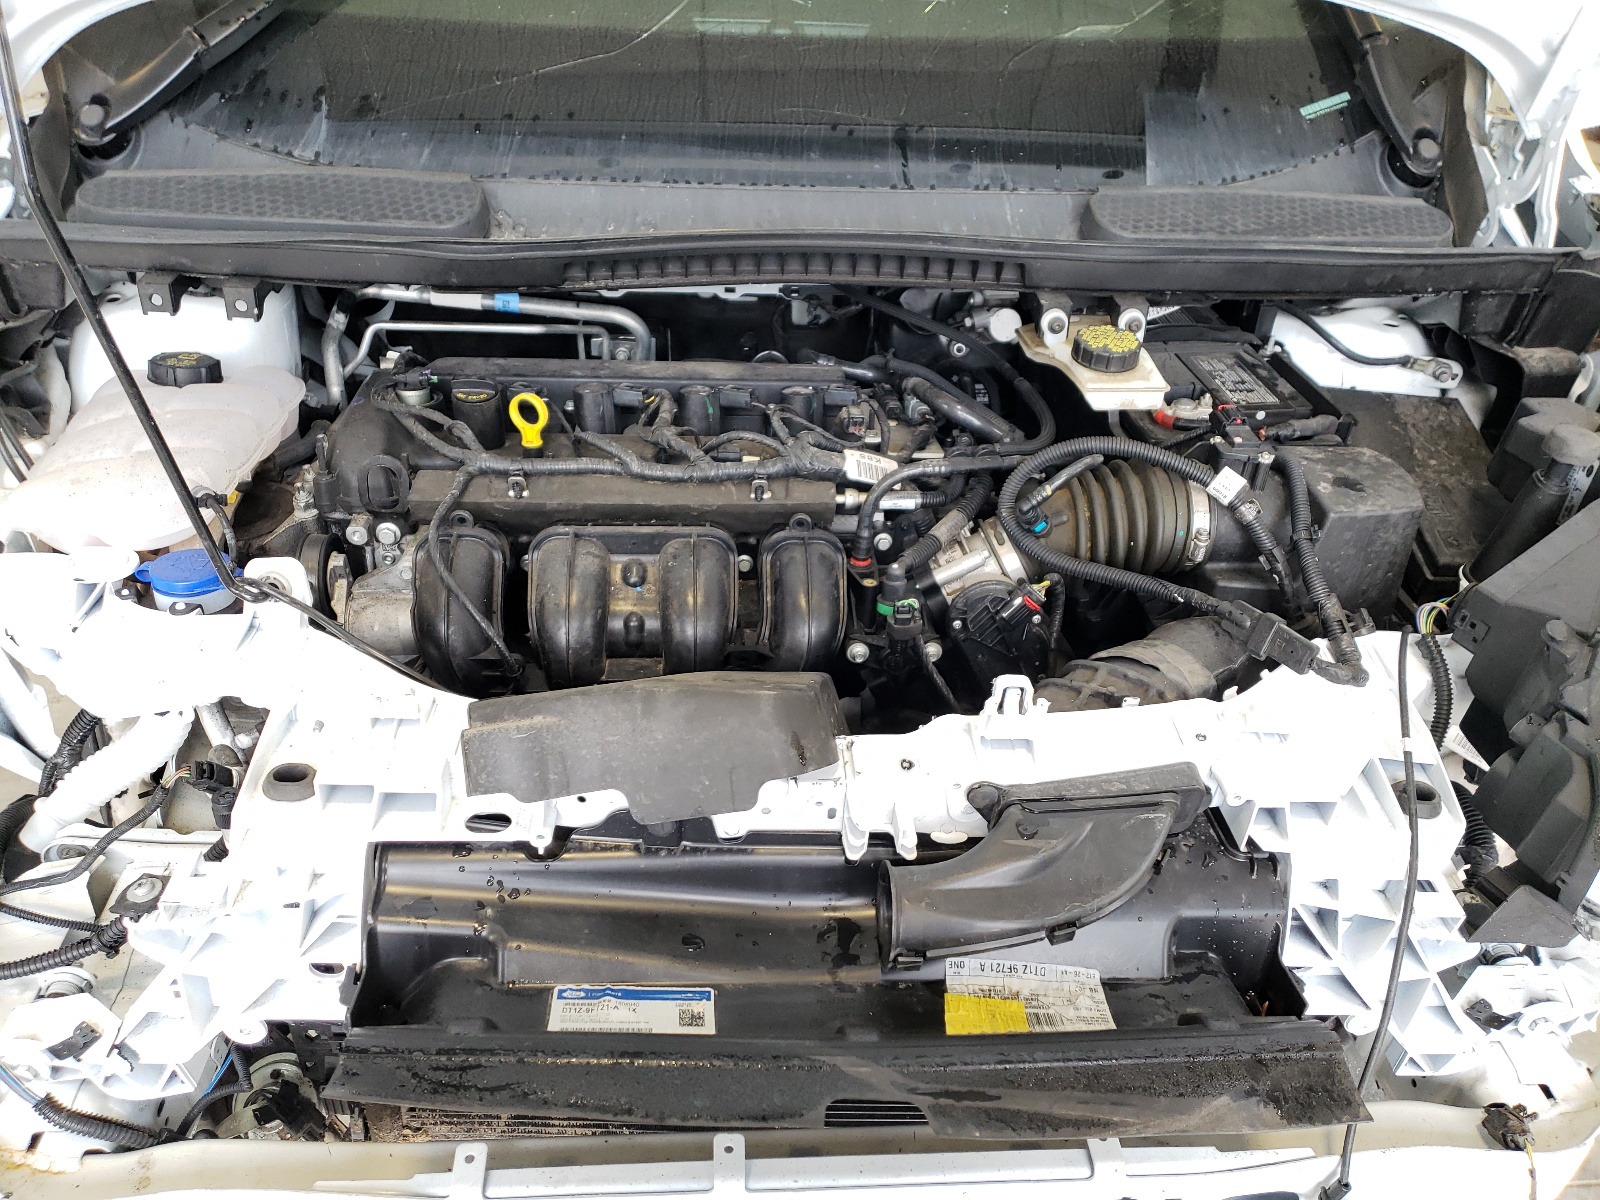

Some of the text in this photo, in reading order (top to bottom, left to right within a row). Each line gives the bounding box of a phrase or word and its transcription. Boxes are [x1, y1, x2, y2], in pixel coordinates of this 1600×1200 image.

[948, 960, 965, 969] ONE
[979, 961, 1046, 977] DT1Z 9F721 A
